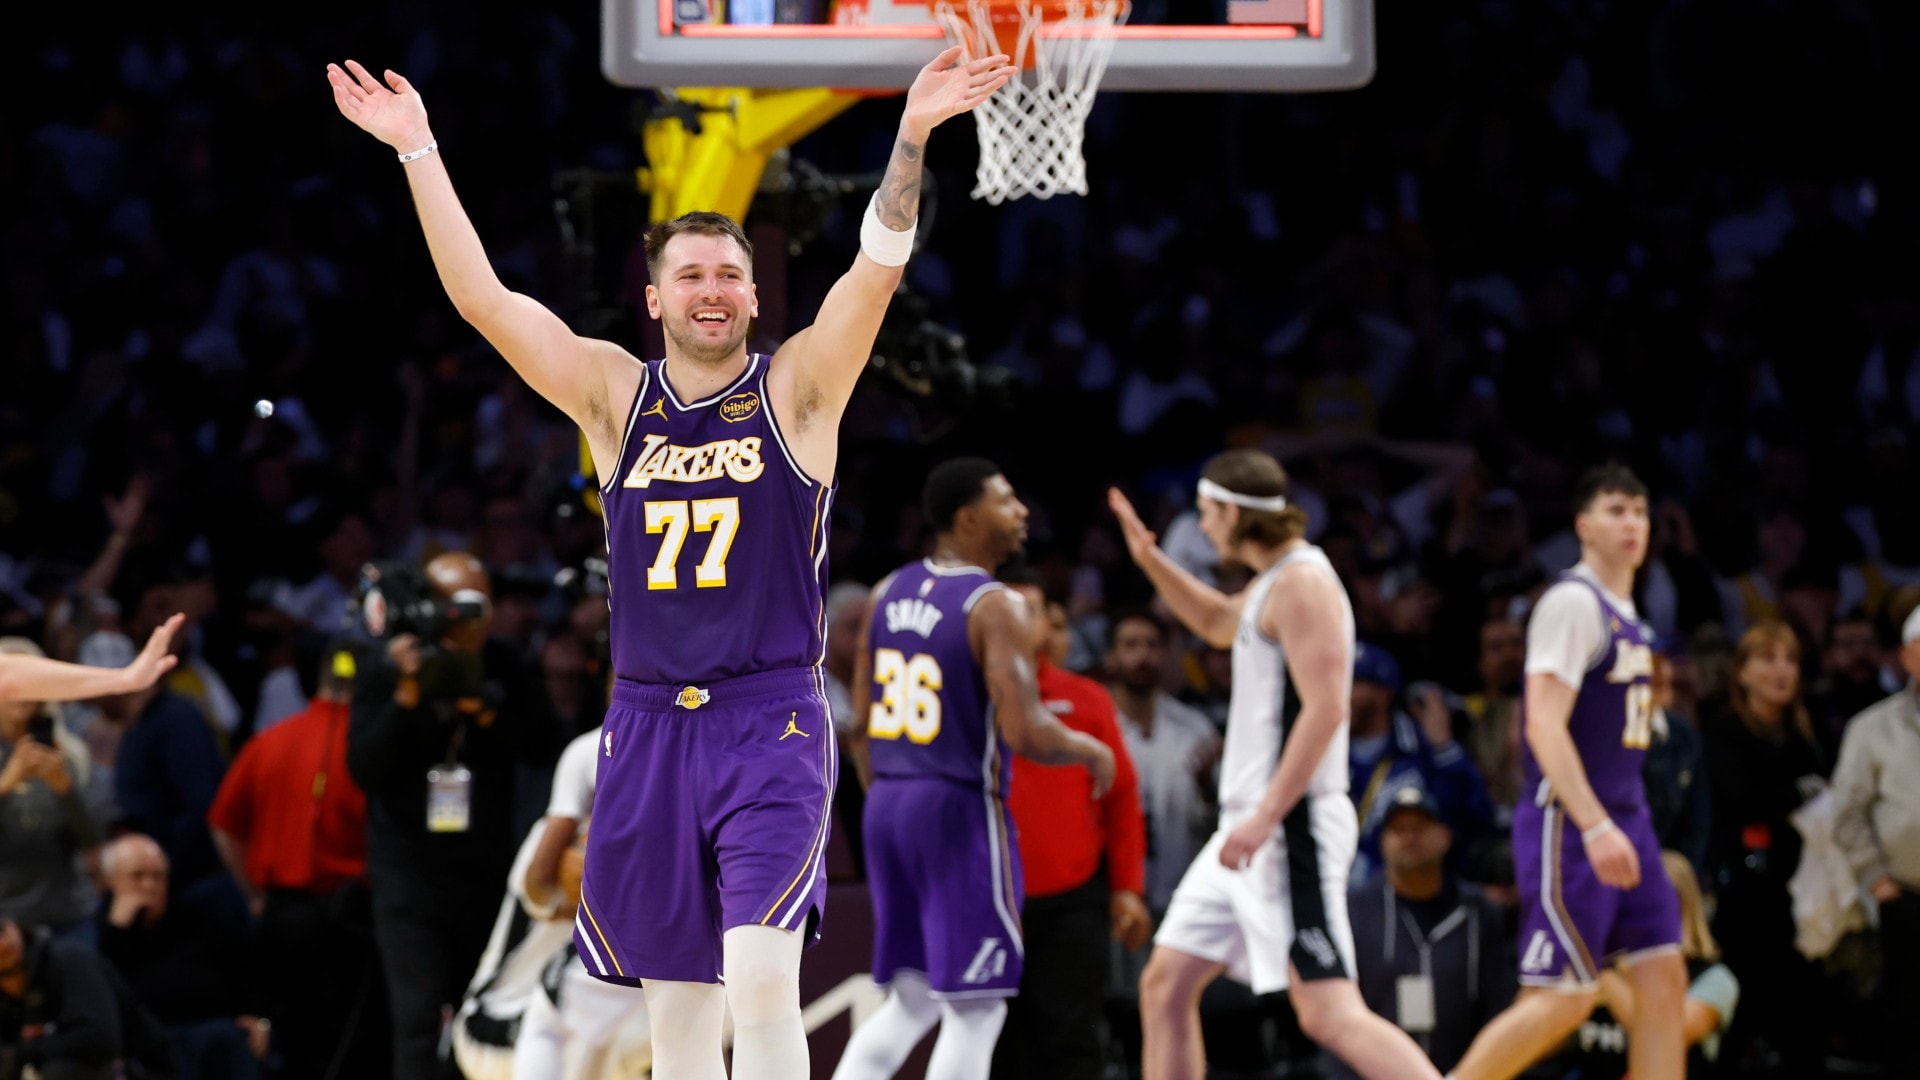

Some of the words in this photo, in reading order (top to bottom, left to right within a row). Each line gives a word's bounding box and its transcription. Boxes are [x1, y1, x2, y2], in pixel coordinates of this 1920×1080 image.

[723, 399, 757, 413] bibigo
[623, 434, 765, 488] LAKERS
[644, 497, 740, 590] 77
[675, 687, 711, 705] LAKERS
[867, 648, 943, 745] 36
